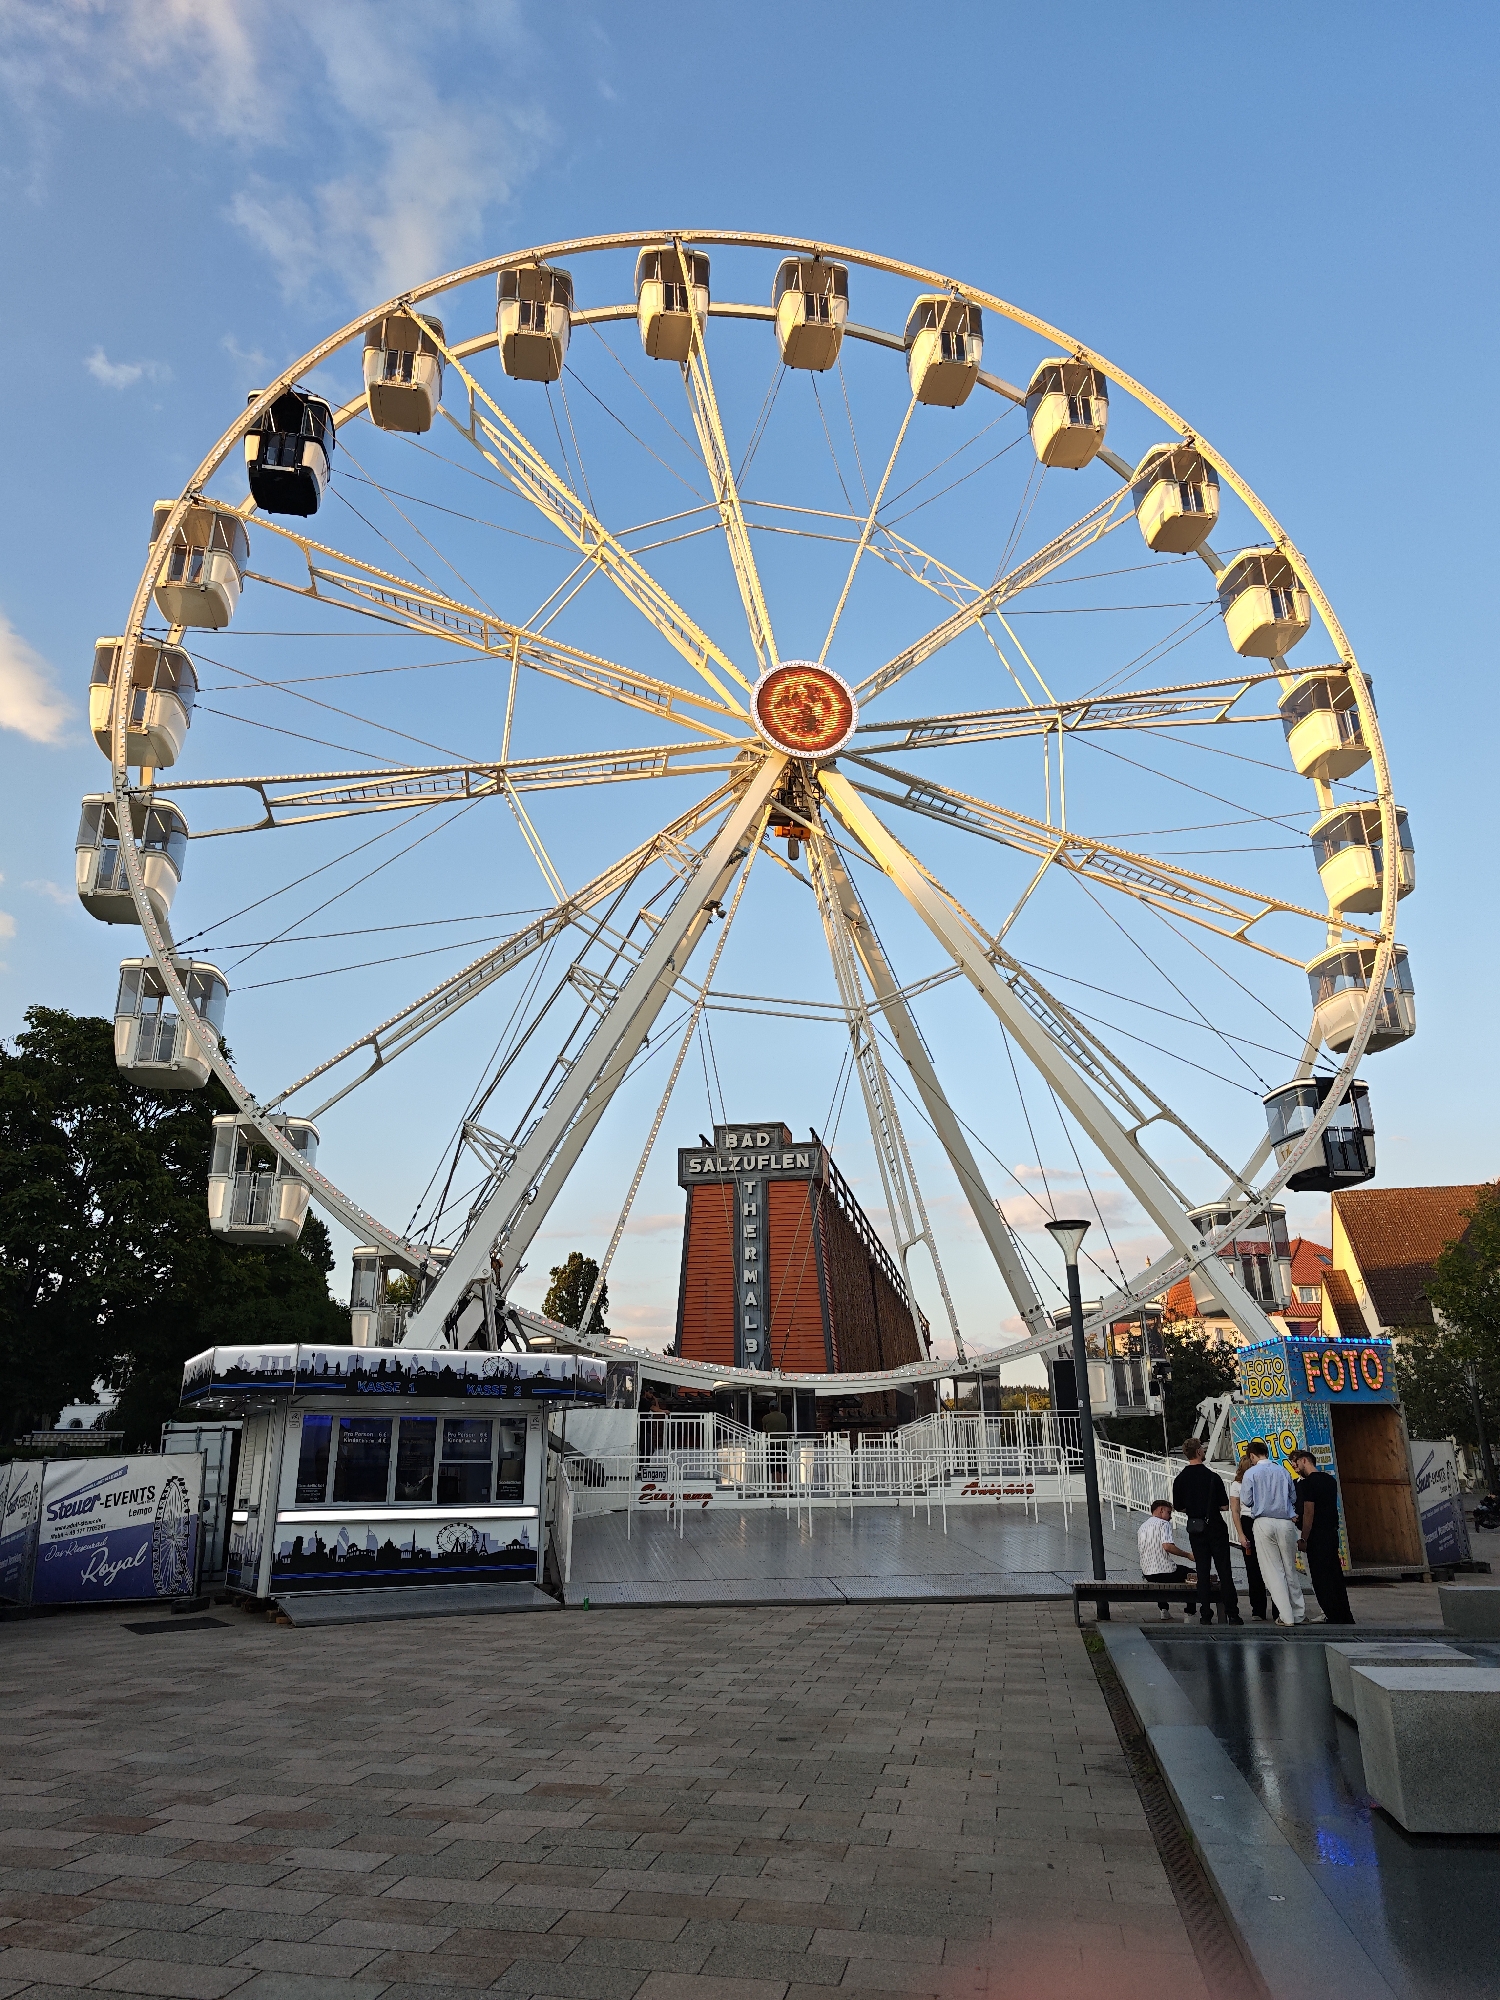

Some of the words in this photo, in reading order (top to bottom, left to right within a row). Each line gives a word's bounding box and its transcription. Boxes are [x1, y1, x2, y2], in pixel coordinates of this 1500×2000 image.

[725, 1132, 771, 1148] BAD
[688, 1153, 810, 1173] SALZUFLEN
[1245, 1357, 1284, 1377] FOTO
[1302, 1348, 1384, 1393] FOTO
[357, 1380, 401, 1393] KASSE
[407, 1382, 417, 1394] 1
[466, 1383, 508, 1396] KASSE
[513, 1385, 522, 1397] 2
[1247, 1375, 1288, 1397] BOX
[642, 1468, 667, 1481] Eingang
[128, 1506, 153, 1518] Lemgo
[80, 1541, 149, 1587] Royal
